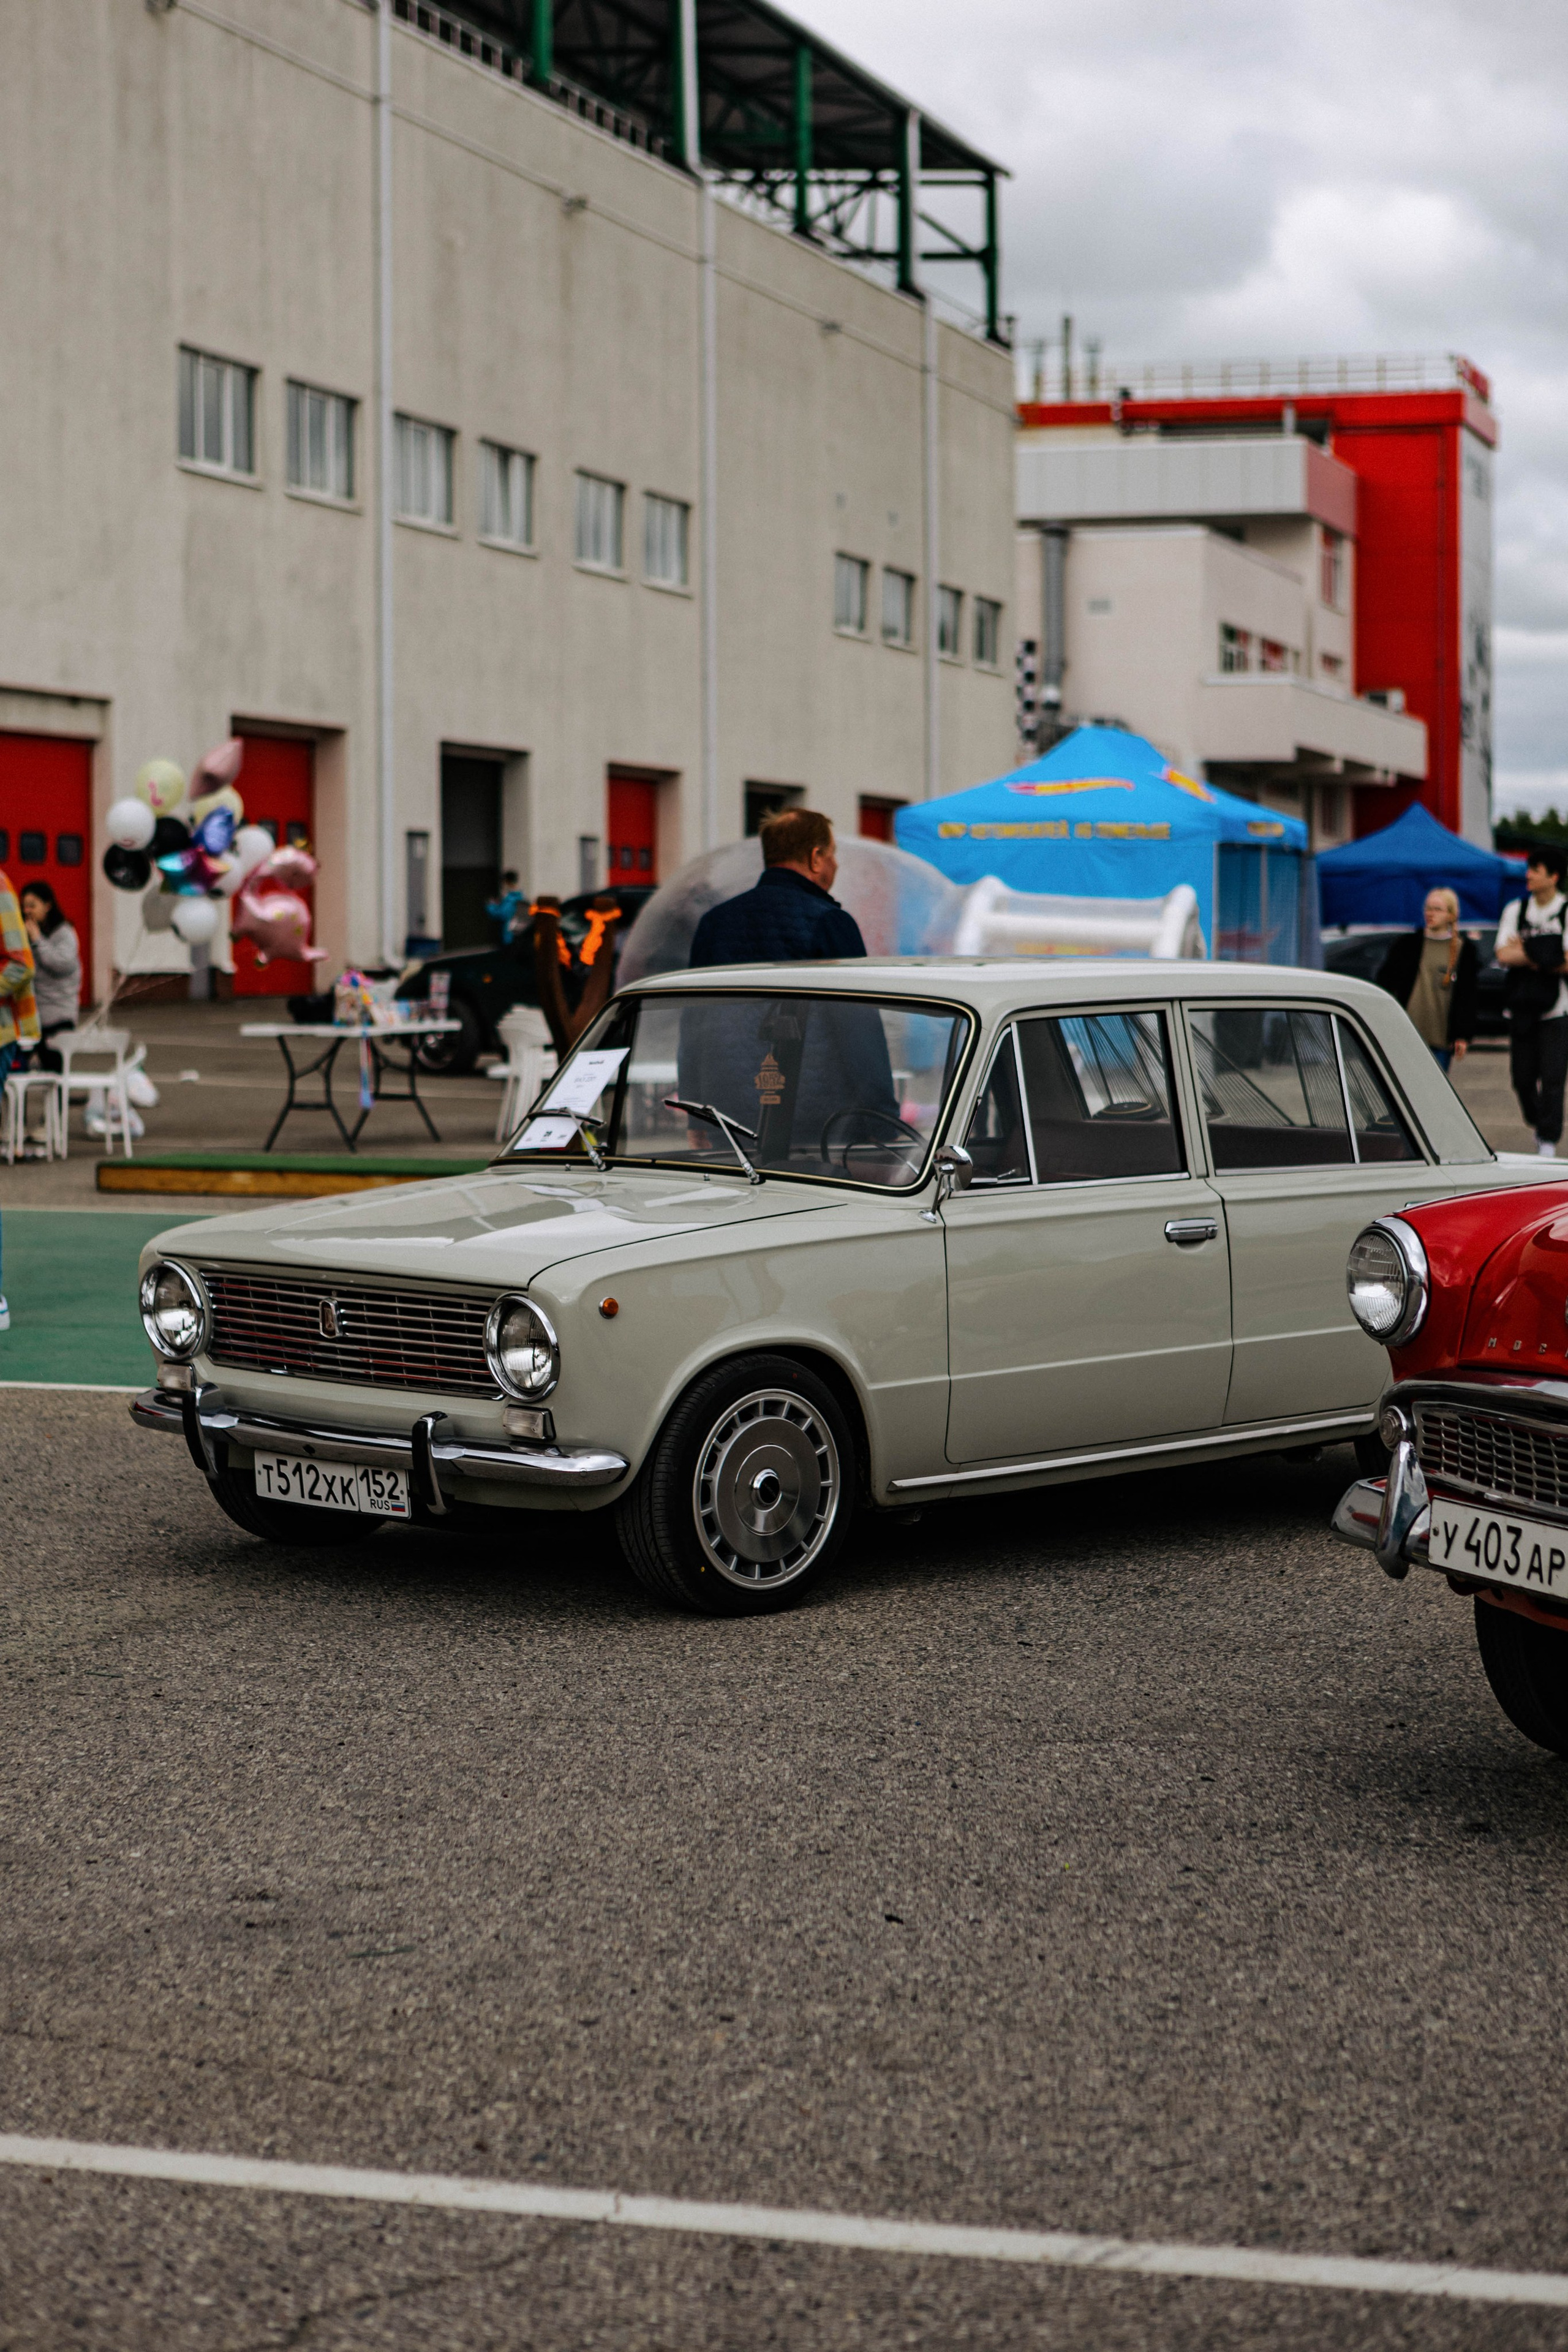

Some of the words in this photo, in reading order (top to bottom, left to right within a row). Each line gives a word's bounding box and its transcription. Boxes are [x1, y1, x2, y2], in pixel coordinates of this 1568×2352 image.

[262, 1458, 356, 1506] Т512ХК
[360, 1468, 400, 1501] 152
[370, 1498, 390, 1510] RUS
